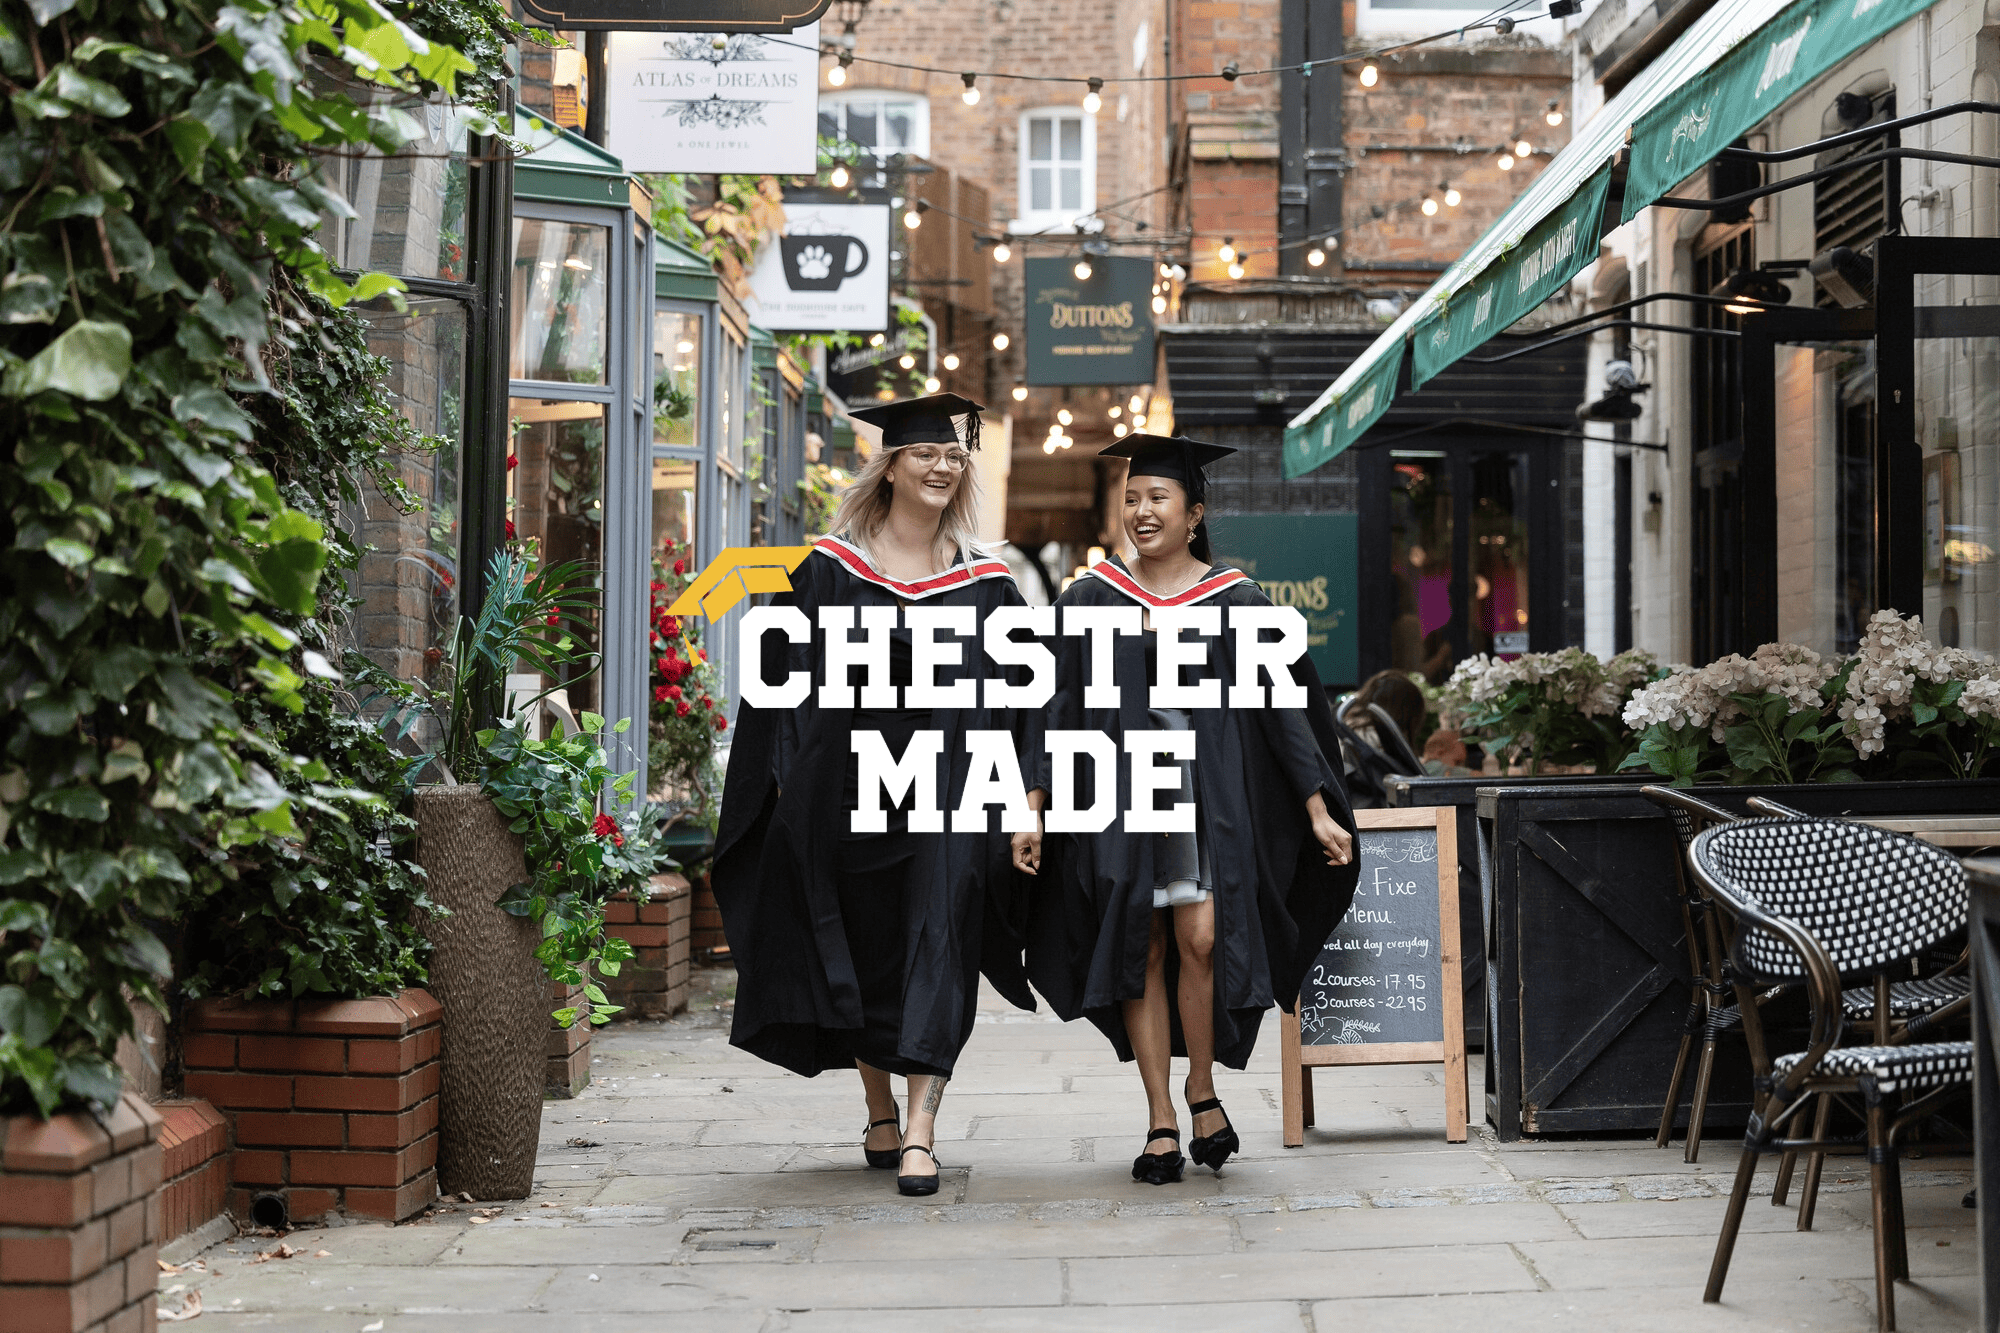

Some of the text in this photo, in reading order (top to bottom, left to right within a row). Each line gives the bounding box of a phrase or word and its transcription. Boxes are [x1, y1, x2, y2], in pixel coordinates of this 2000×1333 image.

[633, 72, 695, 87] ATLAS
[717, 73, 798, 88] DREAMS
[689, 141, 711, 149] ONE
[716, 141, 750, 150] JEWEL
[1050, 301, 1133, 329] DUTTONS
[1372, 867, 1417, 896] Fixe
[1344, 939, 1361, 950] all
[1363, 938, 1382, 957] day
